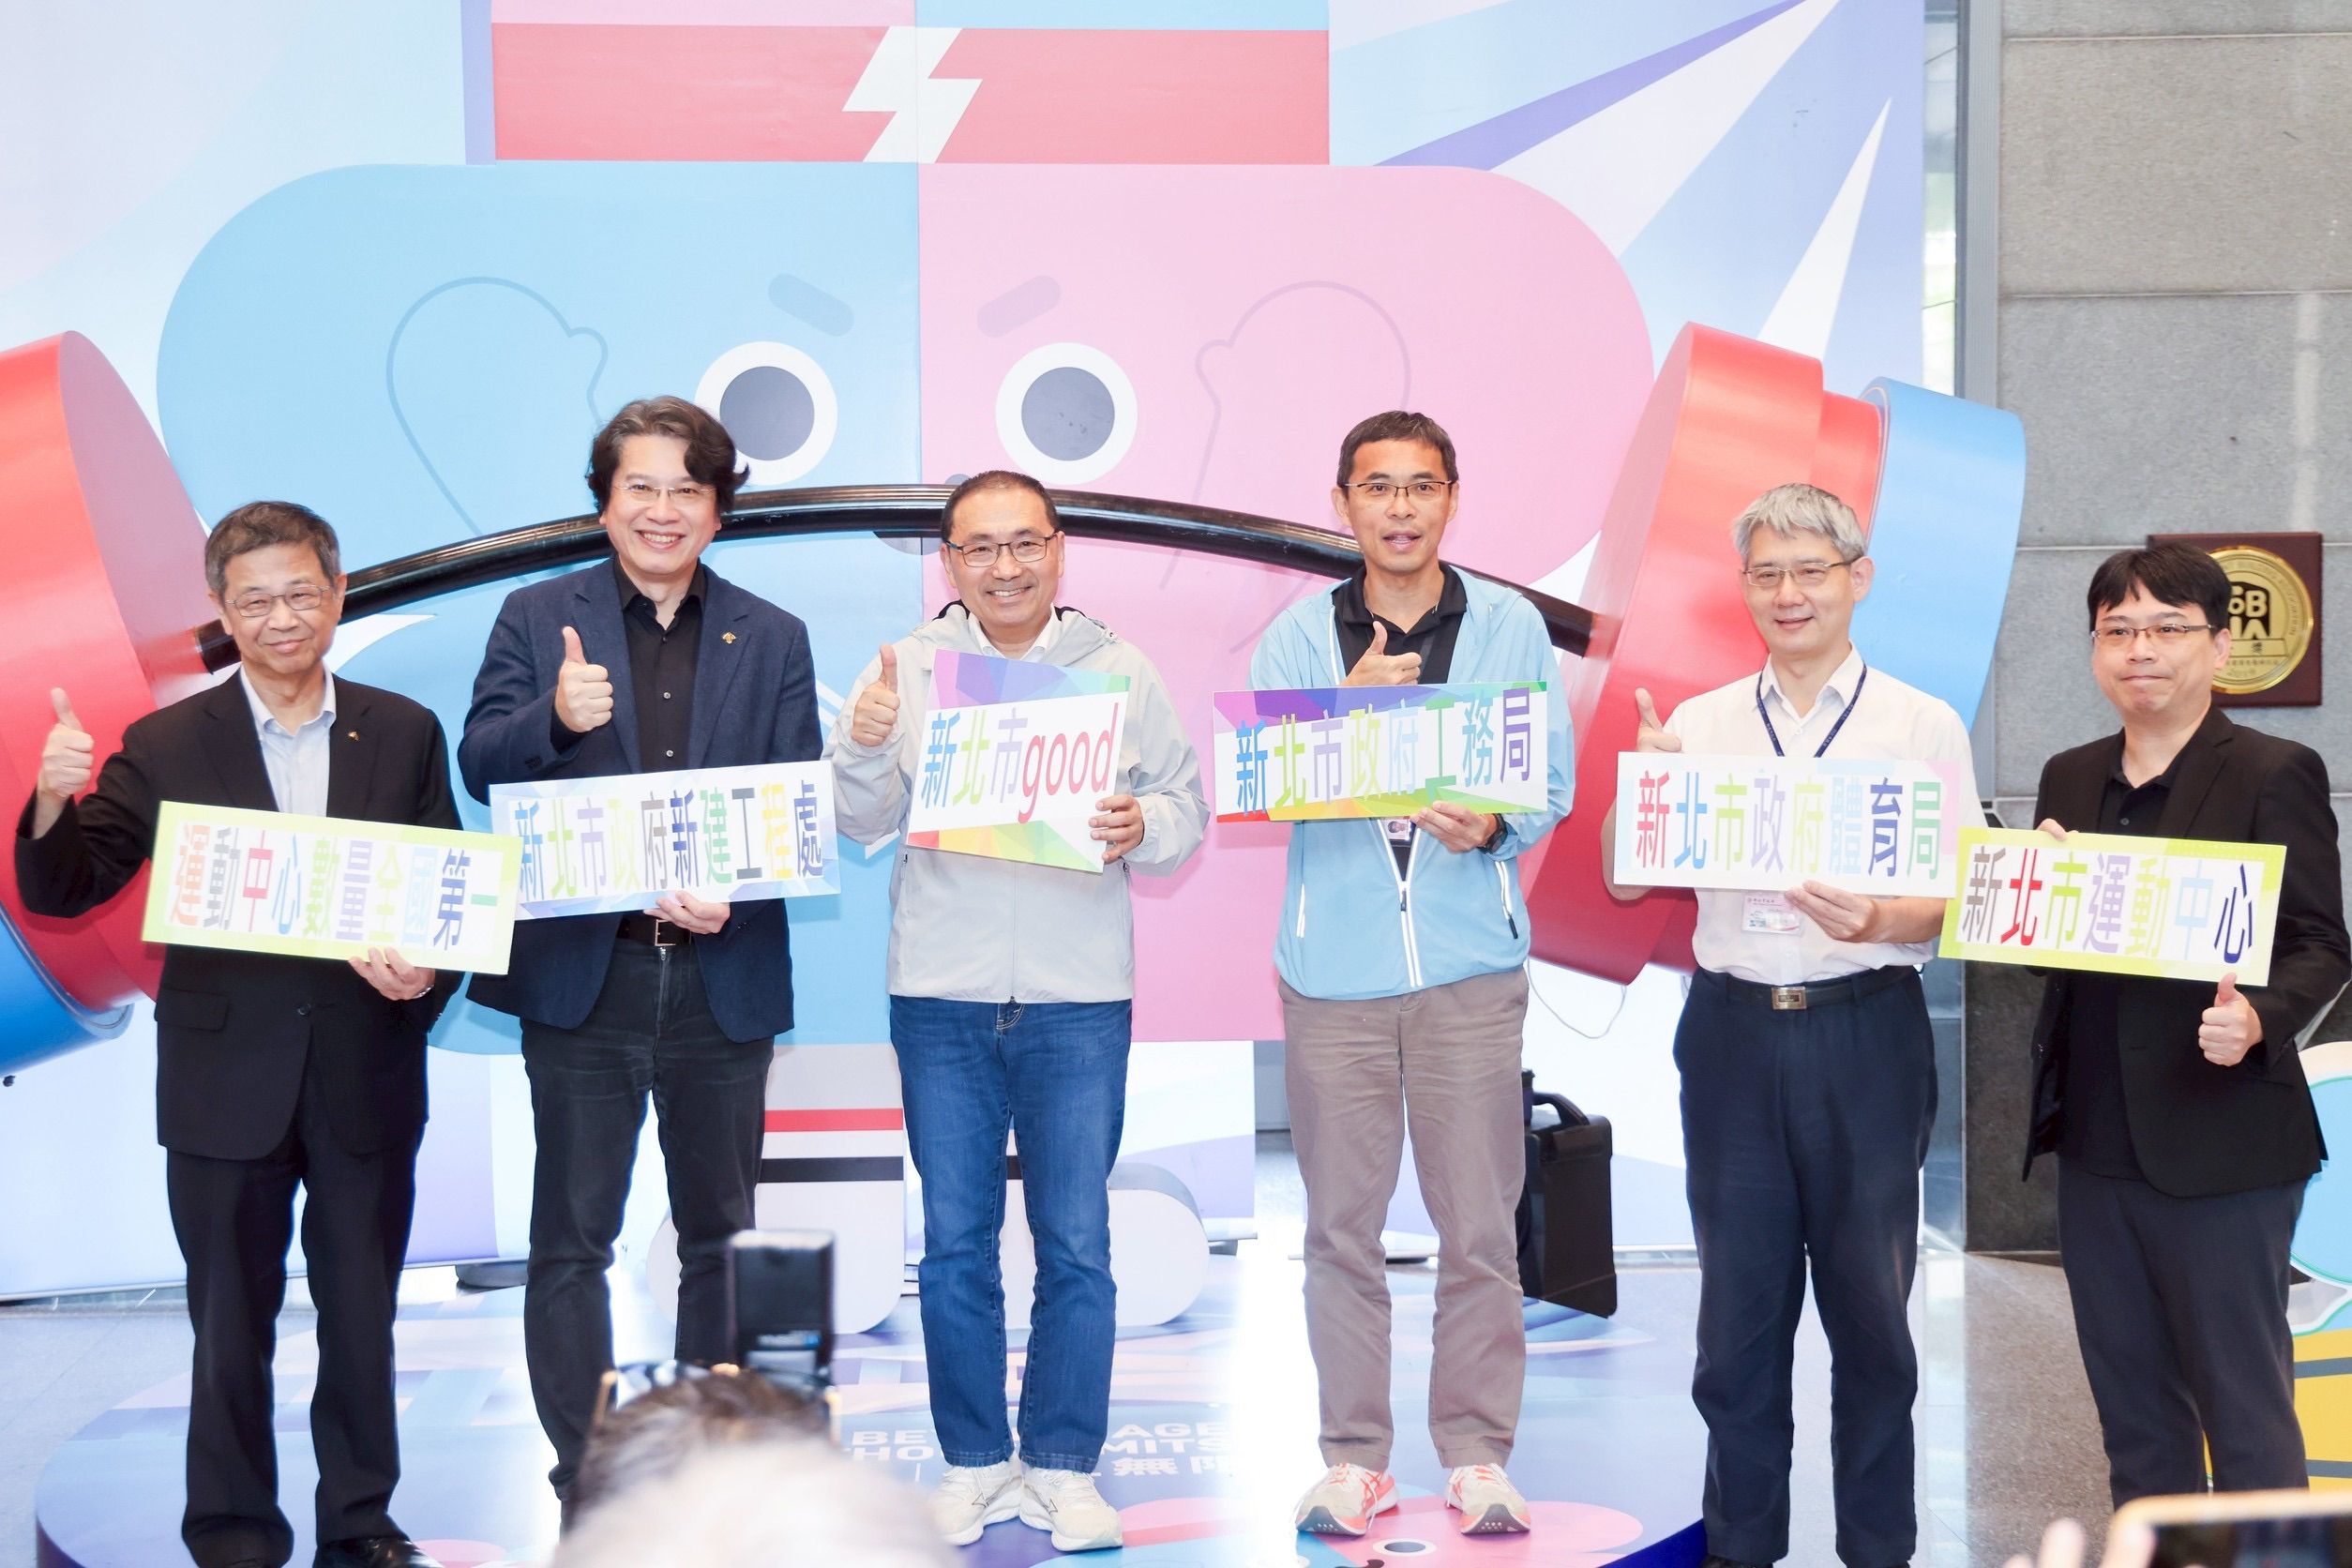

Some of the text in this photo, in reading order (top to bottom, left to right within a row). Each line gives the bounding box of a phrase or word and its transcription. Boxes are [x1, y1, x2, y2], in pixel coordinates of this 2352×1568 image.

[1236, 686, 1530, 815] 新北市政府工務局
[515, 779, 823, 901] 新北市政府新建工程處
[1636, 770, 1942, 880] 新北市政府體育局
[170, 824, 498, 950] 運動中心數量全國第一
[1962, 845, 2253, 964] 新北市運動中心
[1101, 1438, 1233, 1455] MITS
